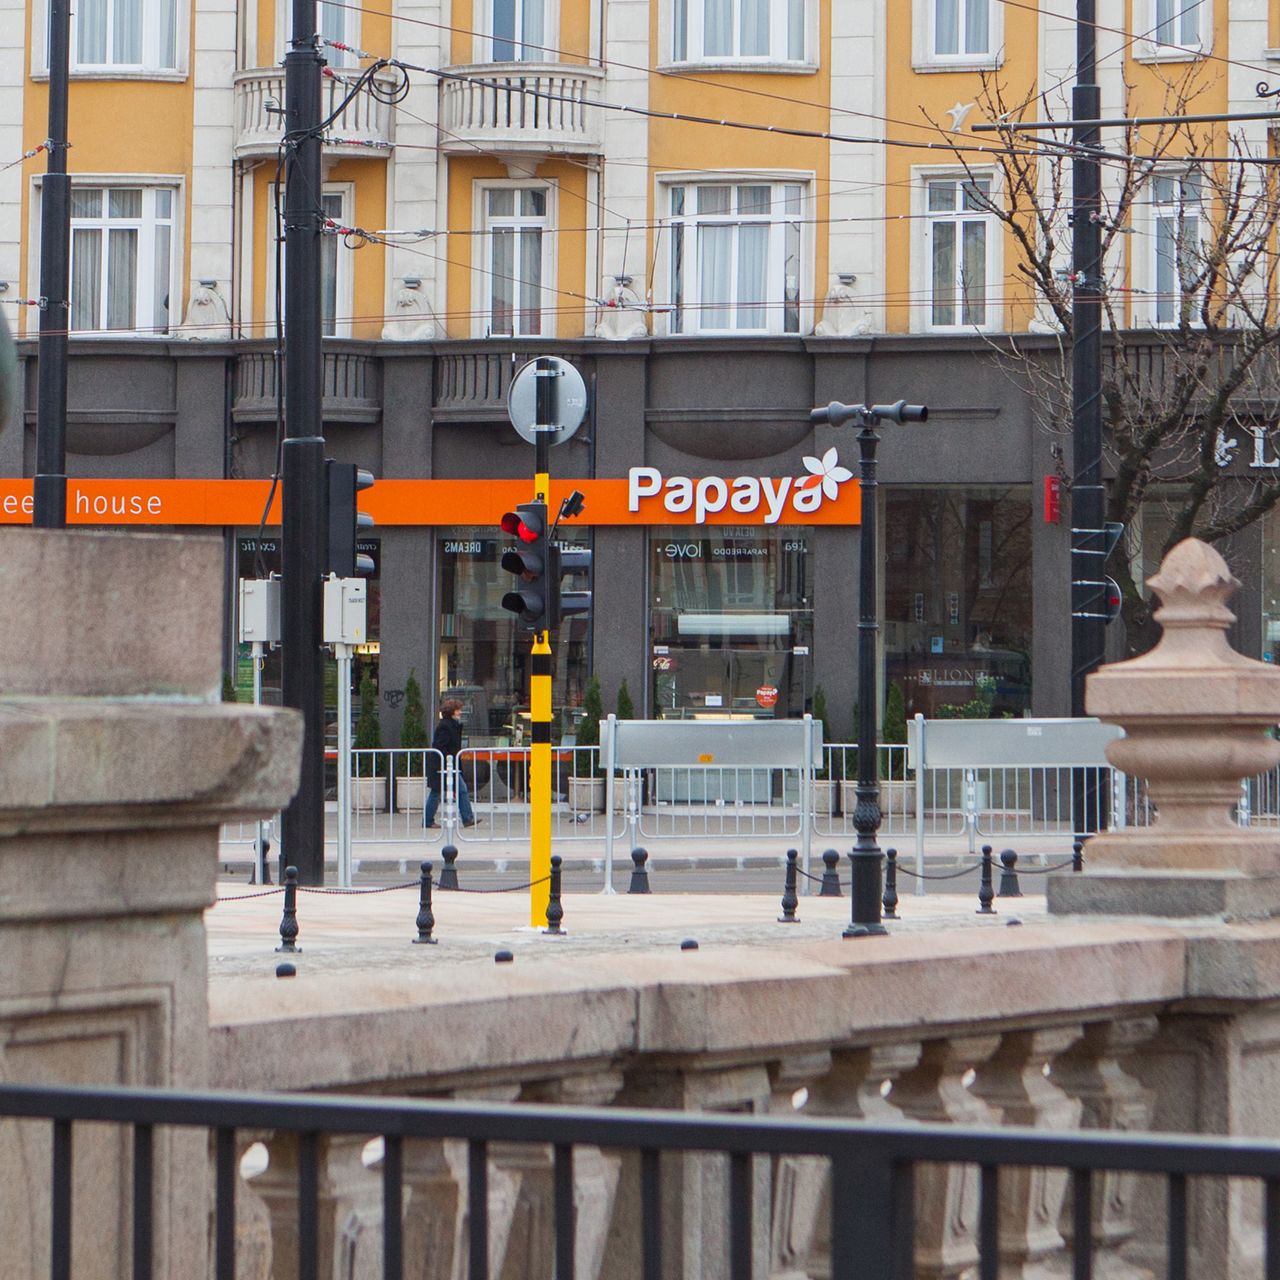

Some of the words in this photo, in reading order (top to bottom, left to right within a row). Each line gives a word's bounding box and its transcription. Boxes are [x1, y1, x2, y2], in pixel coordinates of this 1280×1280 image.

[75, 489, 162, 515] house
[628, 467, 823, 524] Papaya
[933, 669, 975, 681] LION
